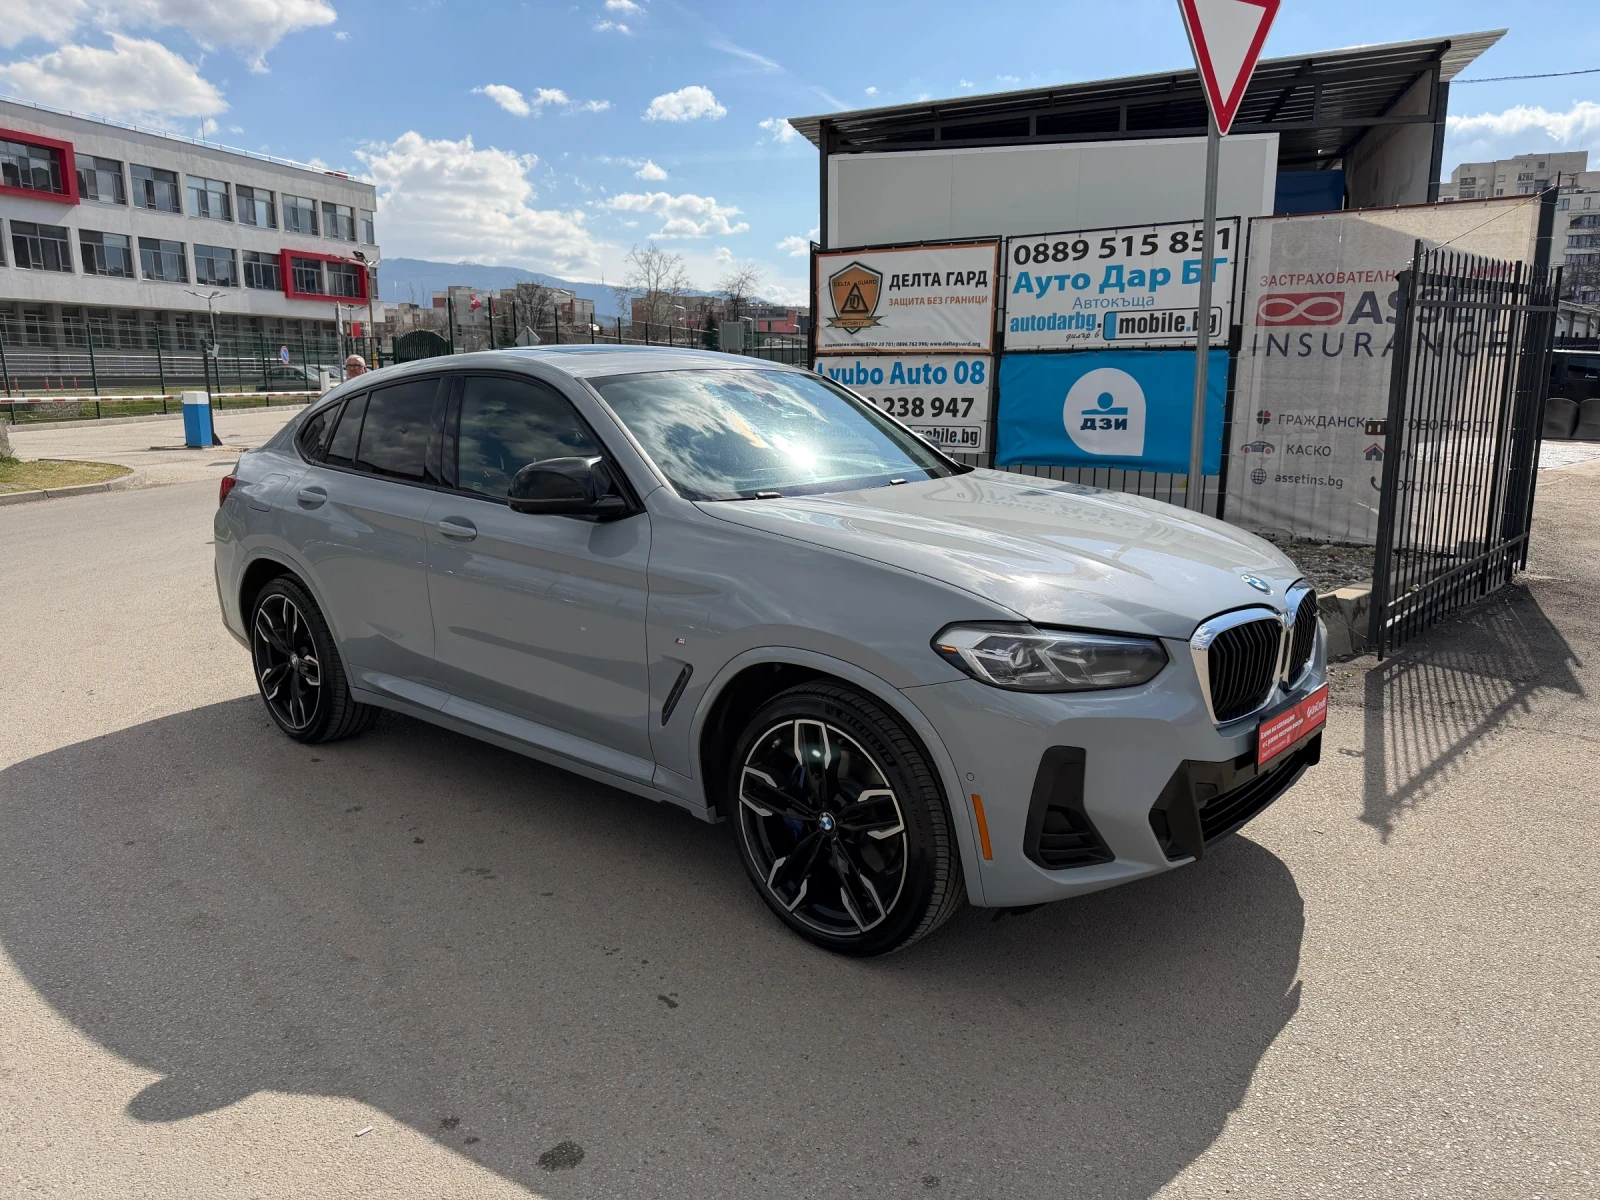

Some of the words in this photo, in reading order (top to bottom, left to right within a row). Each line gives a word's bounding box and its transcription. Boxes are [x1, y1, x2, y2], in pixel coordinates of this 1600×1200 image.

[1013, 239, 1090, 266] 0889
[1098, 233, 1159, 259] 515
[1168, 227, 1230, 254] 851
[889, 272, 942, 291] ДЕЛТА
[946, 270, 988, 288] ГАРД
[1012, 271, 1091, 300] Ауто
[1098, 264, 1172, 295] Дар
[1181, 257, 1228, 285] БГ
[1260, 270, 1397, 287] ЗАСТРАХОВАТЕЛН
[888, 298, 926, 307] ЗАЩИТА
[927, 297, 943, 305] БЕЗ
[945, 295, 988, 305] ГРАНИЦИ
[1072, 295, 1155, 311] Автокъща
[890, 361, 946, 385] Auto
[953, 360, 985, 385] 08
[883, 397, 925, 418] 238
[930, 397, 974, 418] 947
[1080, 418, 1128, 431] ДЗИ
[1278, 414, 1374, 429] ГРАЖДАНСК
[1286, 444, 1332, 457] КАСКО
[1274, 473, 1344, 490] assetins.bg
